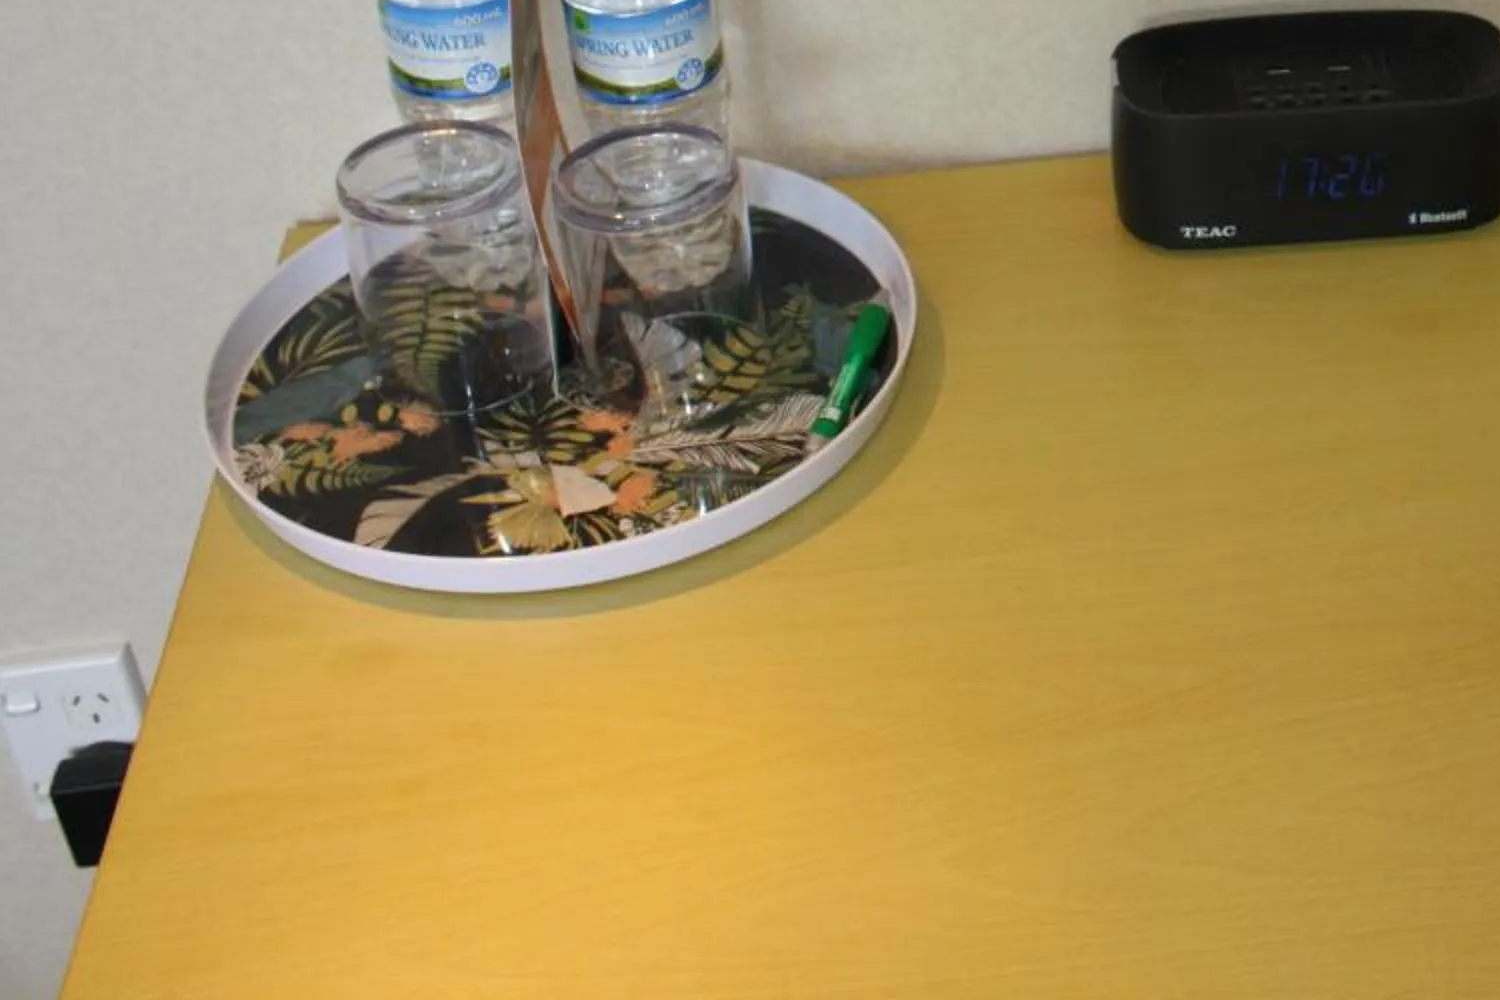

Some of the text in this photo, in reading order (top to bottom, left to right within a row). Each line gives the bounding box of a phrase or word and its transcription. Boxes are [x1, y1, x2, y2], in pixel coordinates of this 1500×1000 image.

[421, 31, 487, 52] WATER
[632, 28, 694, 57] WATER
[1180, 225, 1236, 240] TEAC
